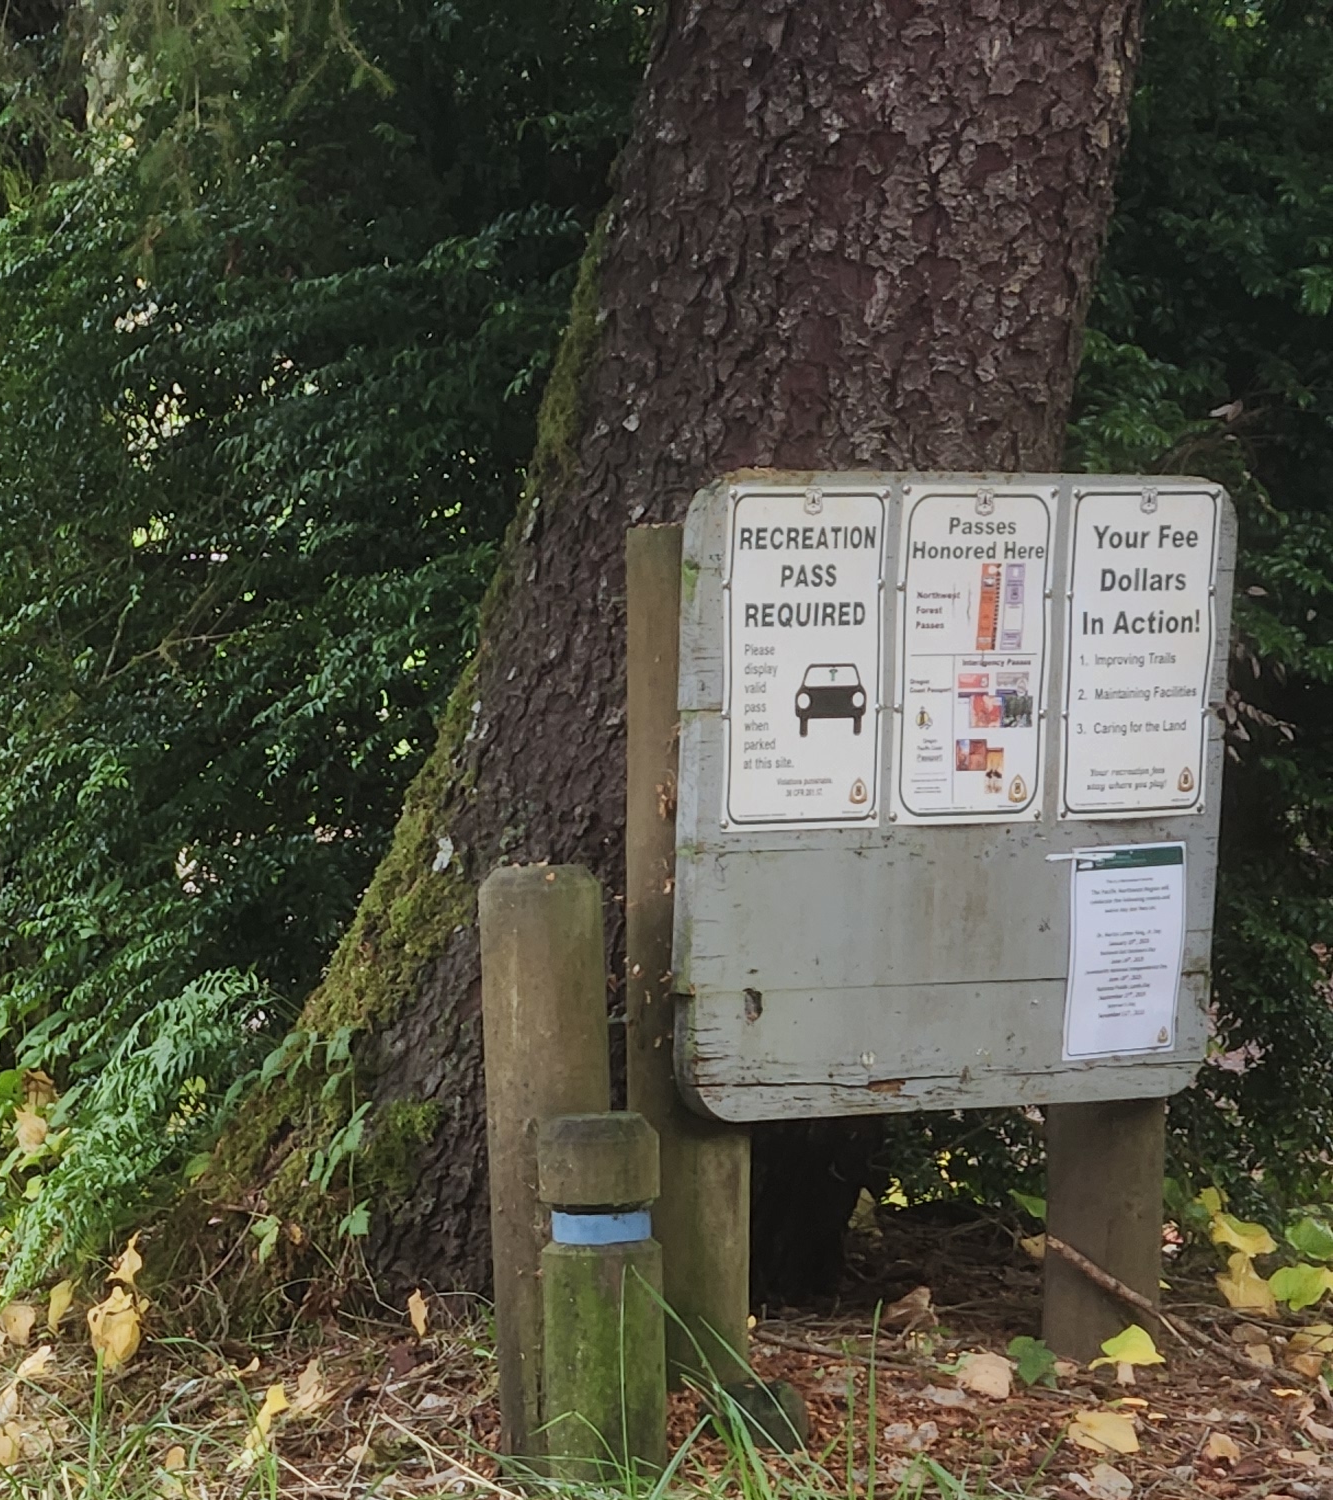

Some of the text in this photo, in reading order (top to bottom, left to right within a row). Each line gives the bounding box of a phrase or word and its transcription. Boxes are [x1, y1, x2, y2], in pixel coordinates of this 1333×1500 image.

[949, 516, 1017, 535] Passes
[739, 526, 877, 550] RECREATION
[1093, 524, 1199, 549] Your Fee
[912, 541, 1045, 559] Honored Here
[780, 563, 837, 588] PASS
[1100, 567, 1187, 592] Dollars
[916, 591, 961, 600] Northwest
[744, 601, 866, 628] REQUIRED
[916, 606, 943, 614] Forest
[915, 621, 945, 629] Passes
[1083, 609, 1200, 635] In Action!
[744, 643, 776, 656] Please
[1079, 652, 1176, 668] 1. Improving Trails
[743, 662, 778, 678] display
[744, 681, 767, 694] valid
[1077, 685, 1197, 701] 2. Maintaining Facilities
[744, 702, 767, 716] pass
[744, 719, 770, 732] when
[1076, 719, 1187, 736] 3. Caring for the Land
[743, 738, 777, 753] parked
[743, 756, 795, 770] at this site.
